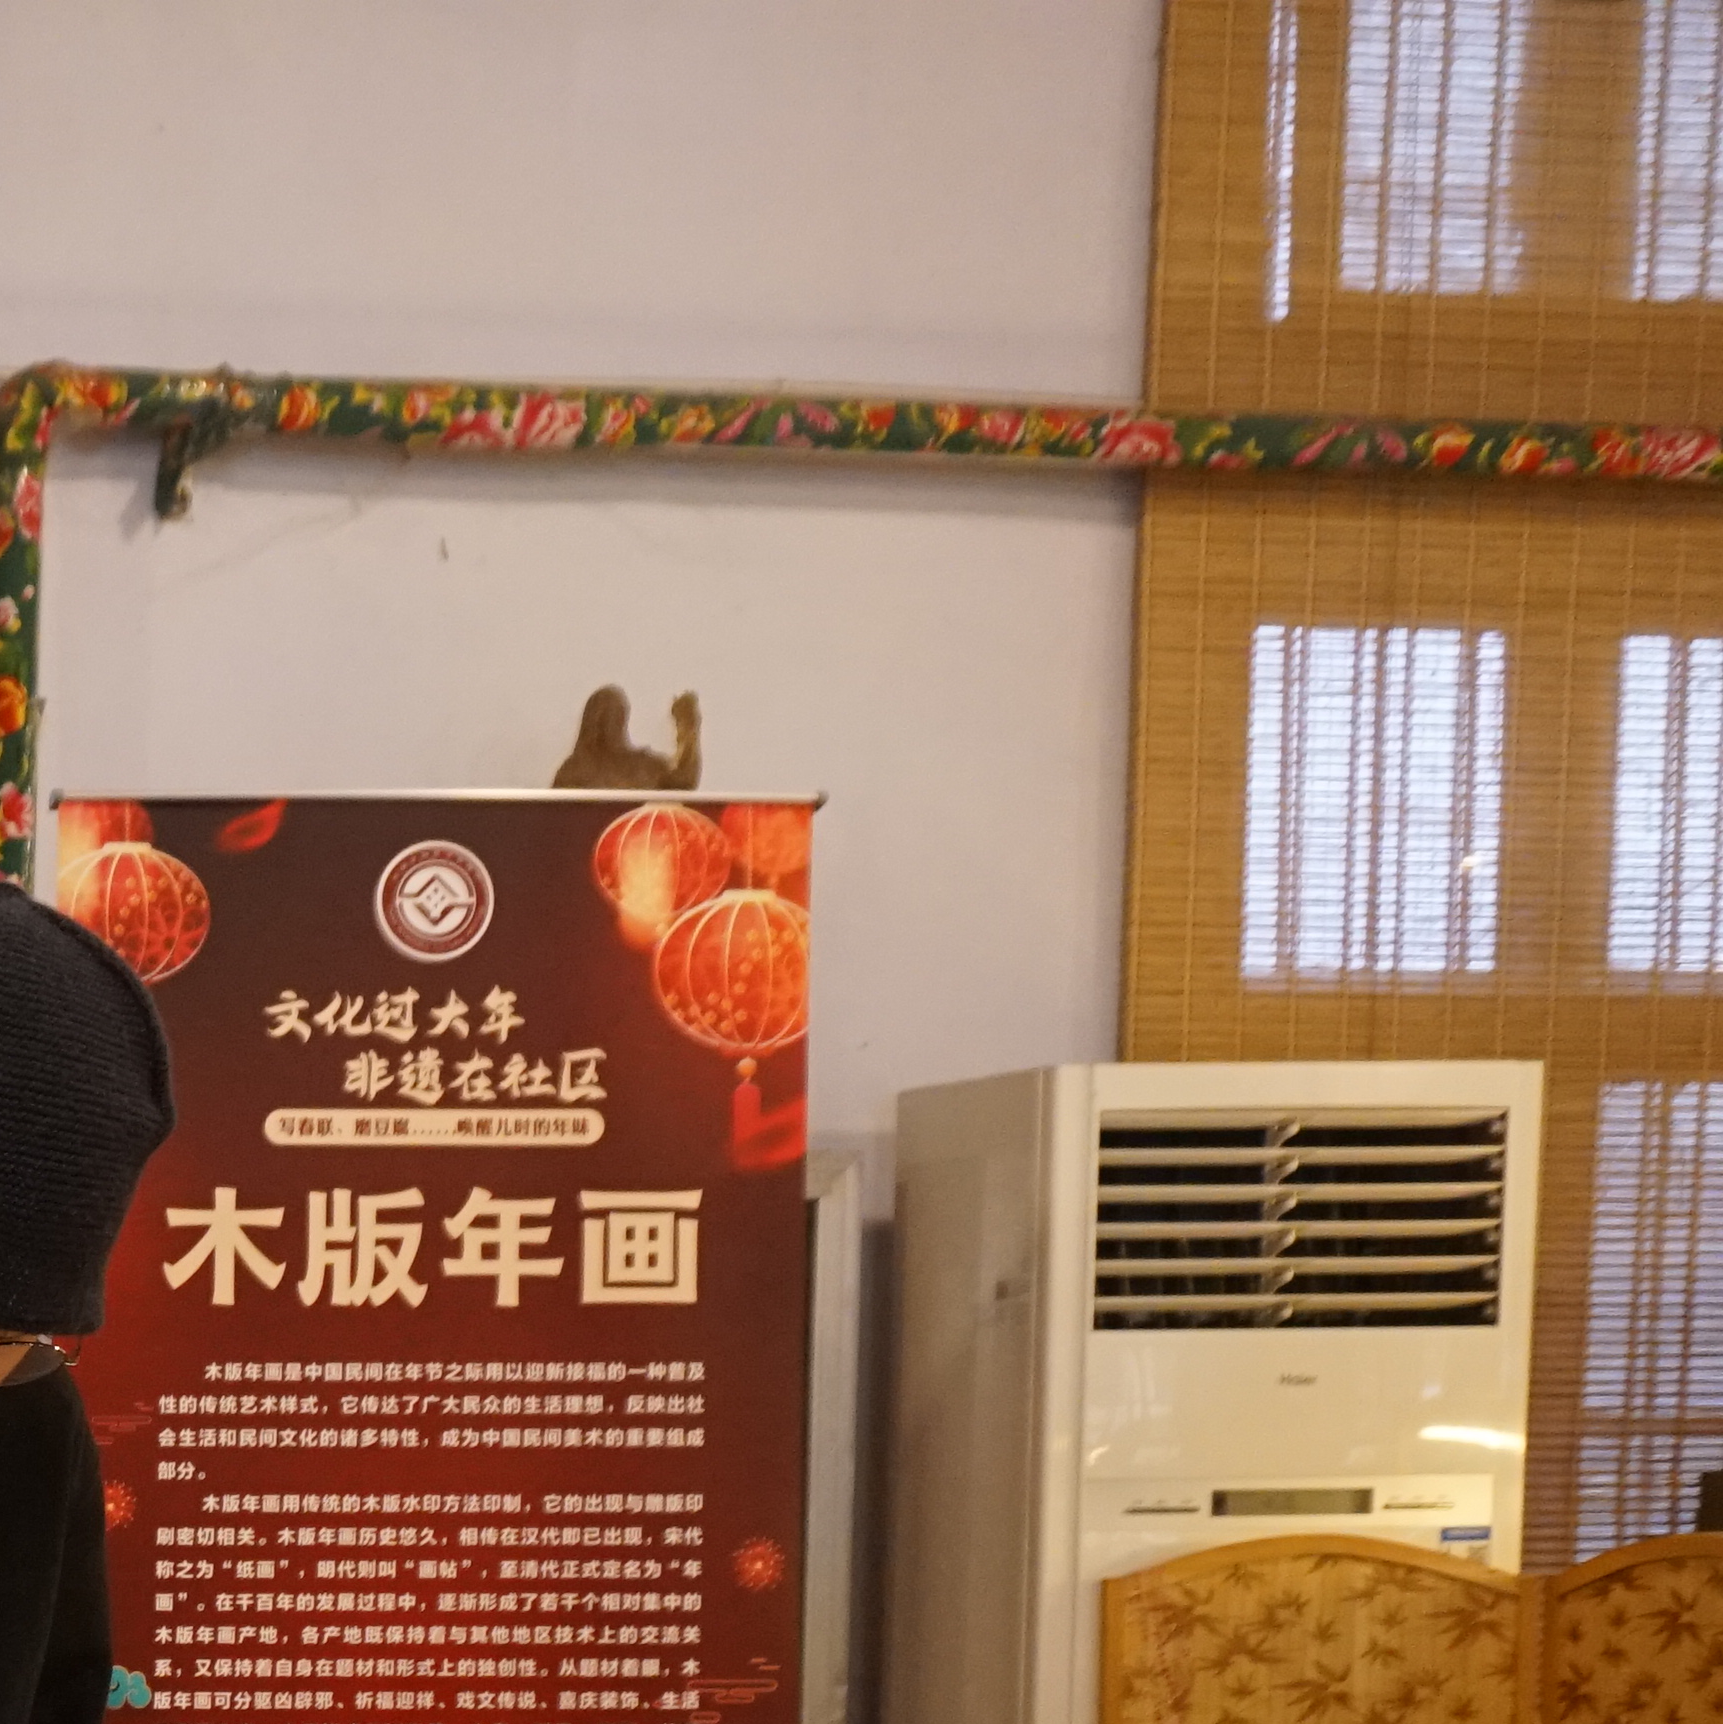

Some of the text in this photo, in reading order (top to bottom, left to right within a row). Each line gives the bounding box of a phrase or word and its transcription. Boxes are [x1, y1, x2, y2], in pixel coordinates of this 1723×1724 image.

[263, 985, 526, 1043] 文化过大年
[341, 1046, 608, 1106] 非遗在社区
[164, 1187, 702, 1306] 木版年画
[158, 1461, 207, 1480] 部分。
